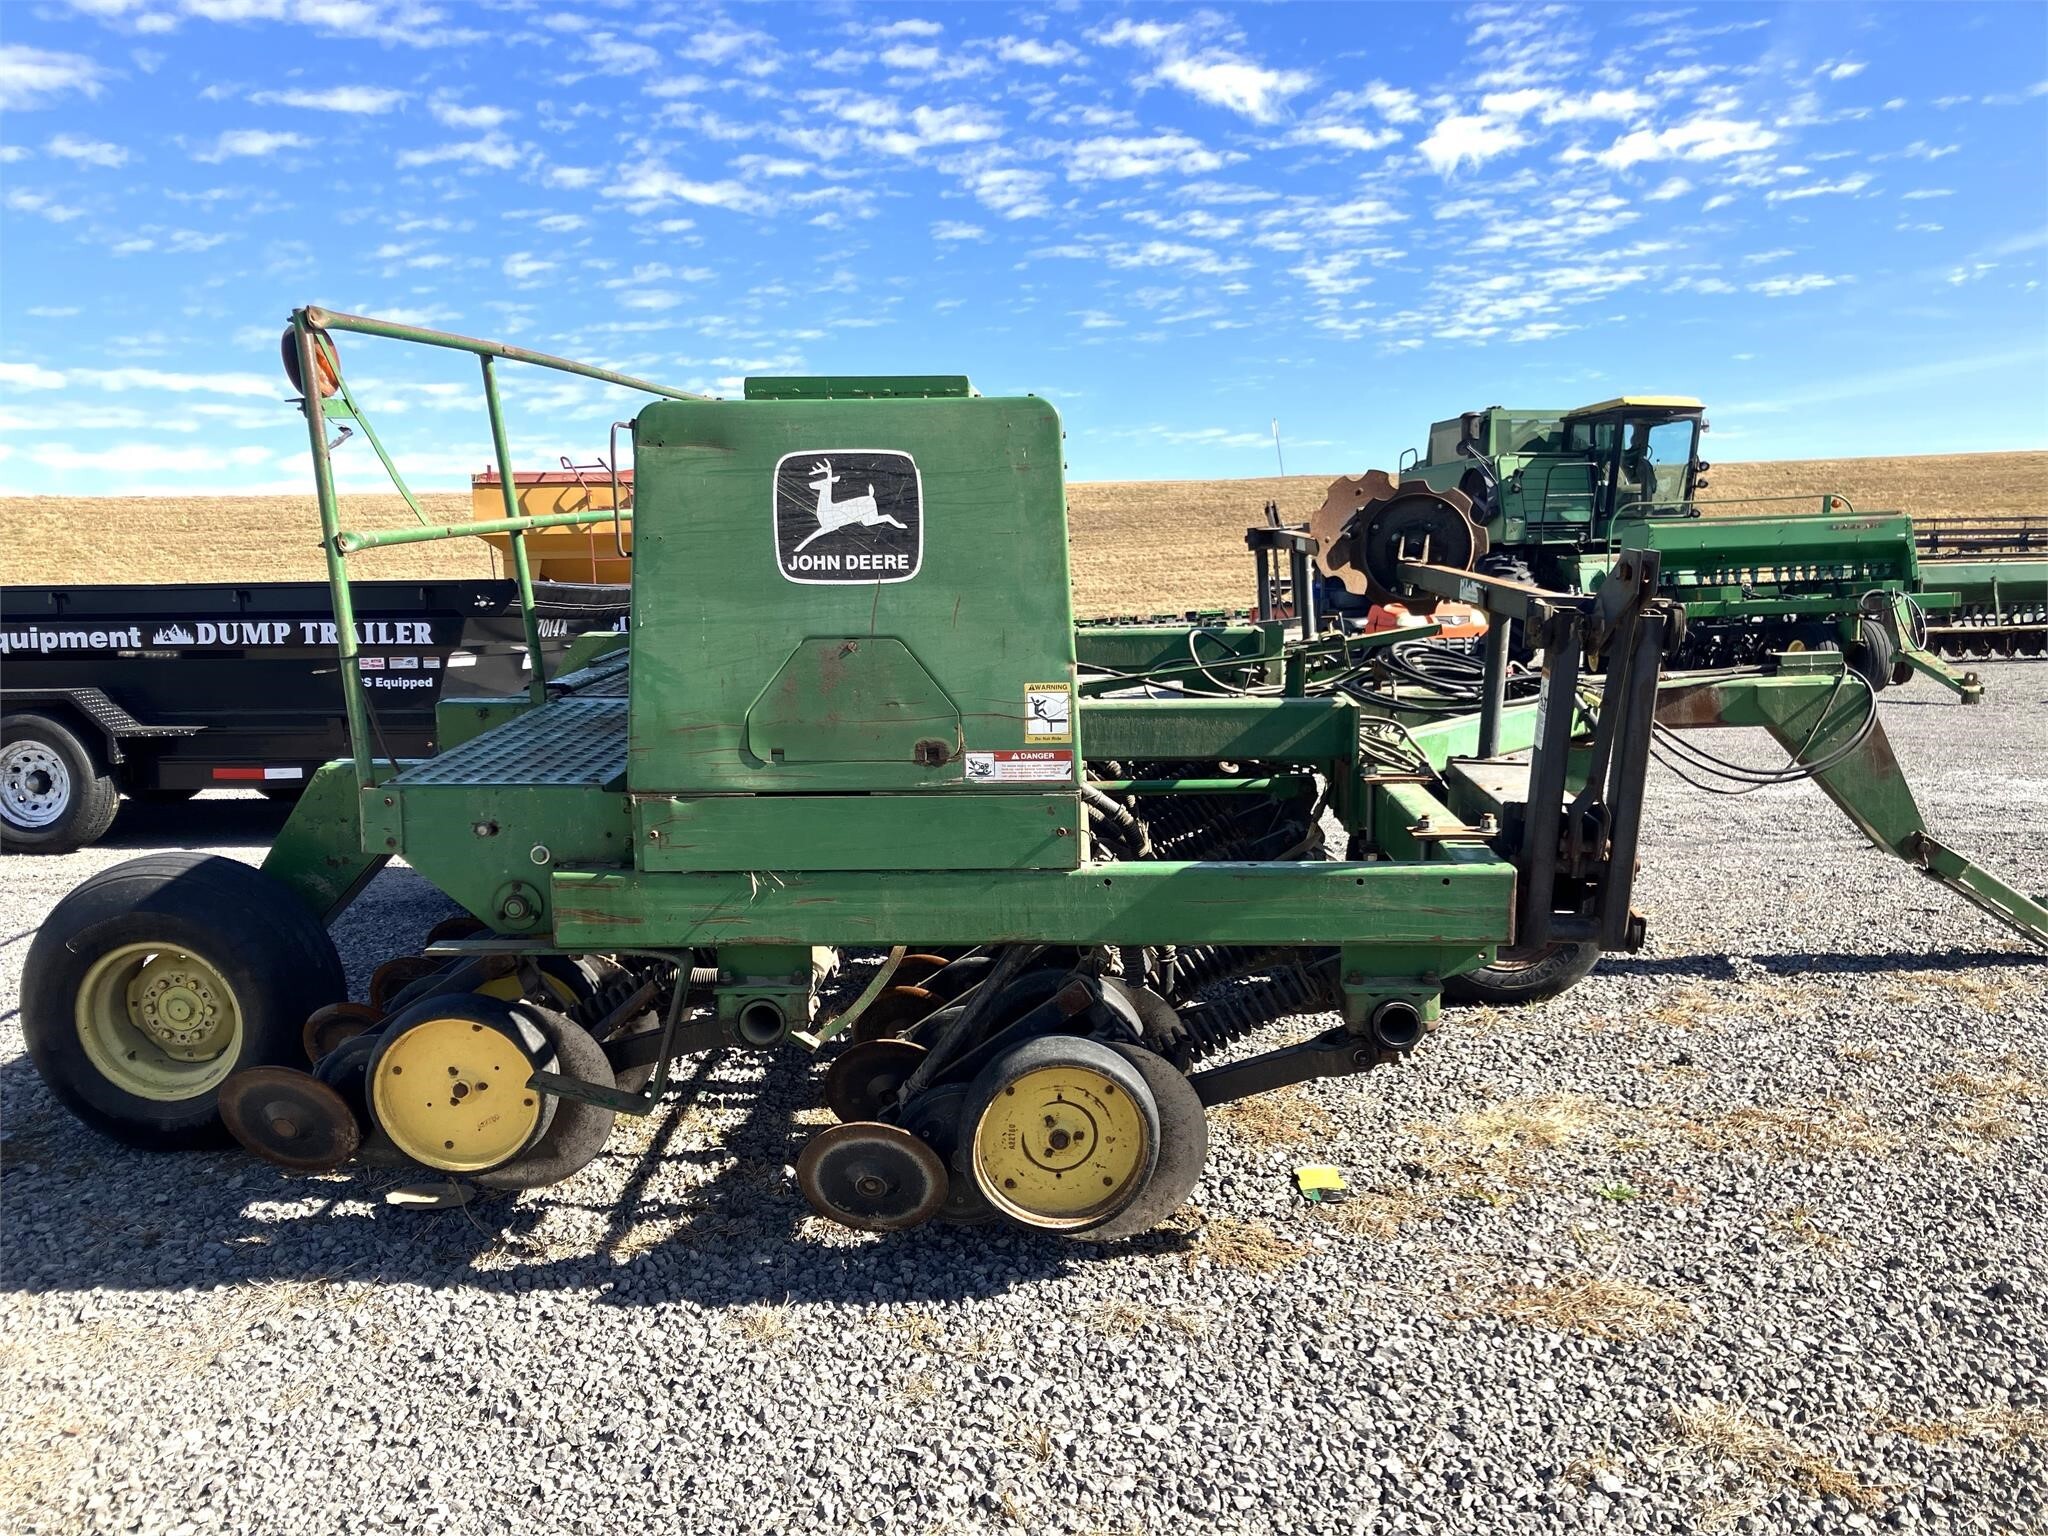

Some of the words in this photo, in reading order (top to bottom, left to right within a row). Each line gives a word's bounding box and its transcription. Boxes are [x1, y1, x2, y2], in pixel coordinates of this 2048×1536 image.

[787, 554, 841, 571] JOHN
[846, 554, 909, 570] DEERE
[196, 622, 291, 645] DUMP
[375, 677, 433, 690] Equipped
[1020, 752, 1055, 760] DANGER
